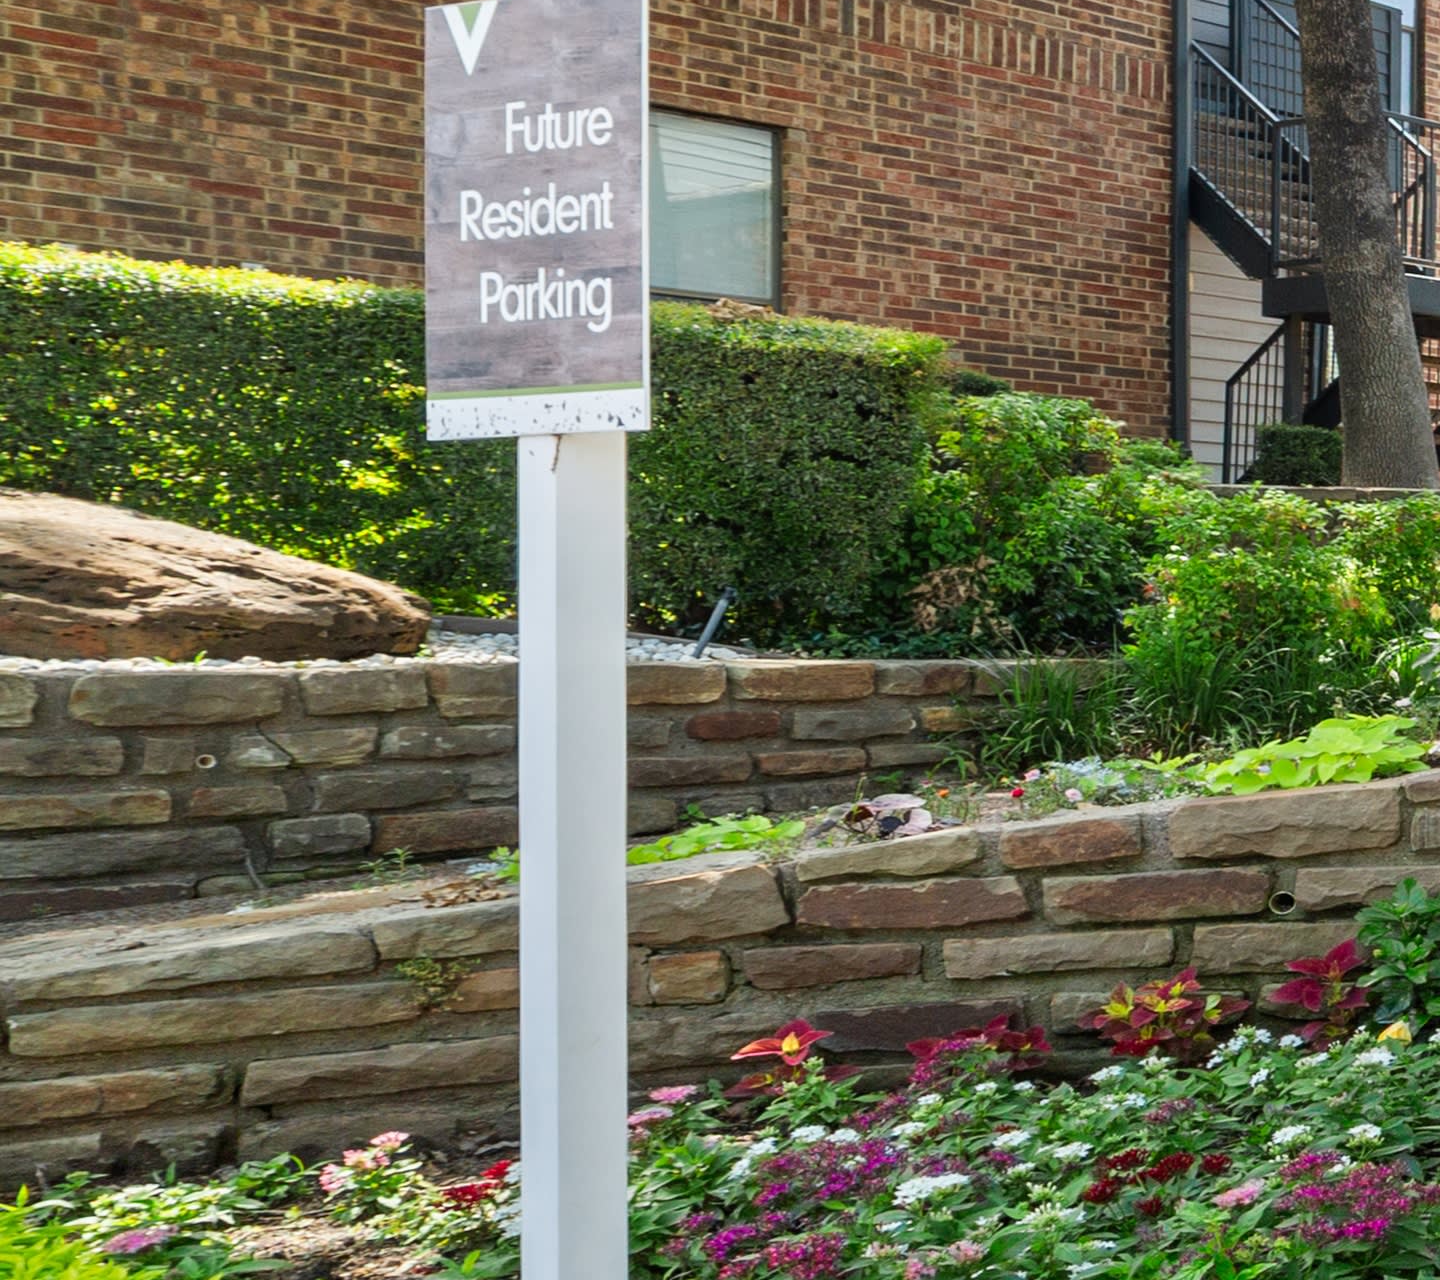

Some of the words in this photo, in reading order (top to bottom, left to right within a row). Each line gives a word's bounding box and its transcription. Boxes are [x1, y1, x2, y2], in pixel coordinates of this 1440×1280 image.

[505, 100, 613, 154] Future
[459, 181, 614, 242] Resident
[480, 267, 613, 334] Parking
